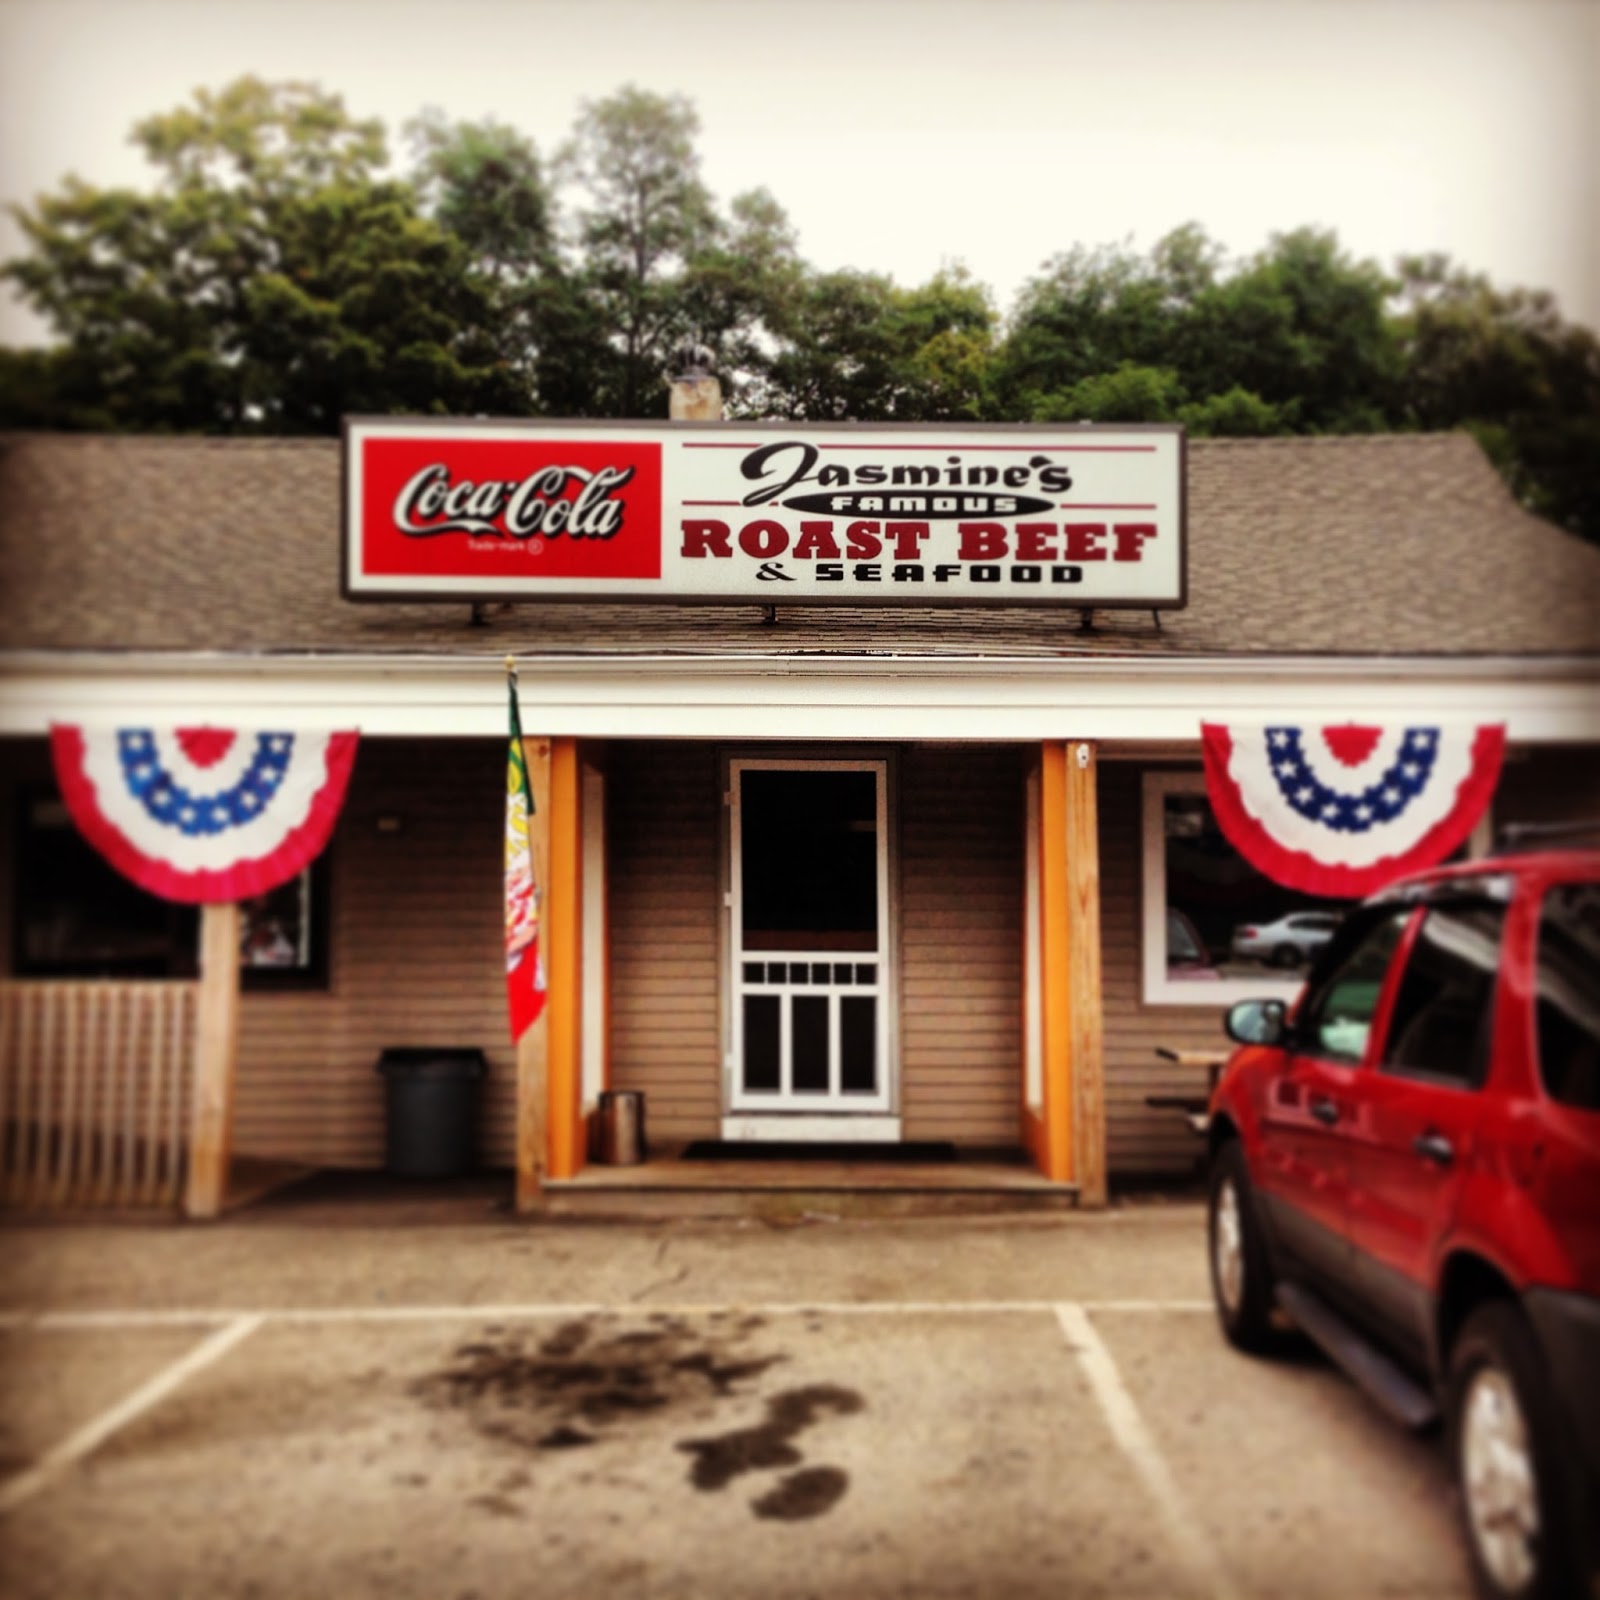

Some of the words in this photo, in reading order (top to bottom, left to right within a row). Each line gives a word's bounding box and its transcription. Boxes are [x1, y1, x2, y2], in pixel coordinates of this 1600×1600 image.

[740, 441, 1073, 507] Jasmine's
[393, 463, 635, 540] Coca-Cola
[831, 495, 1019, 513] FAMOUS
[680, 519, 931, 560] ROAST
[957, 522, 1158, 562] BEEF
[755, 562, 797, 582] &
[815, 563, 1083, 583] SEAFOOD
